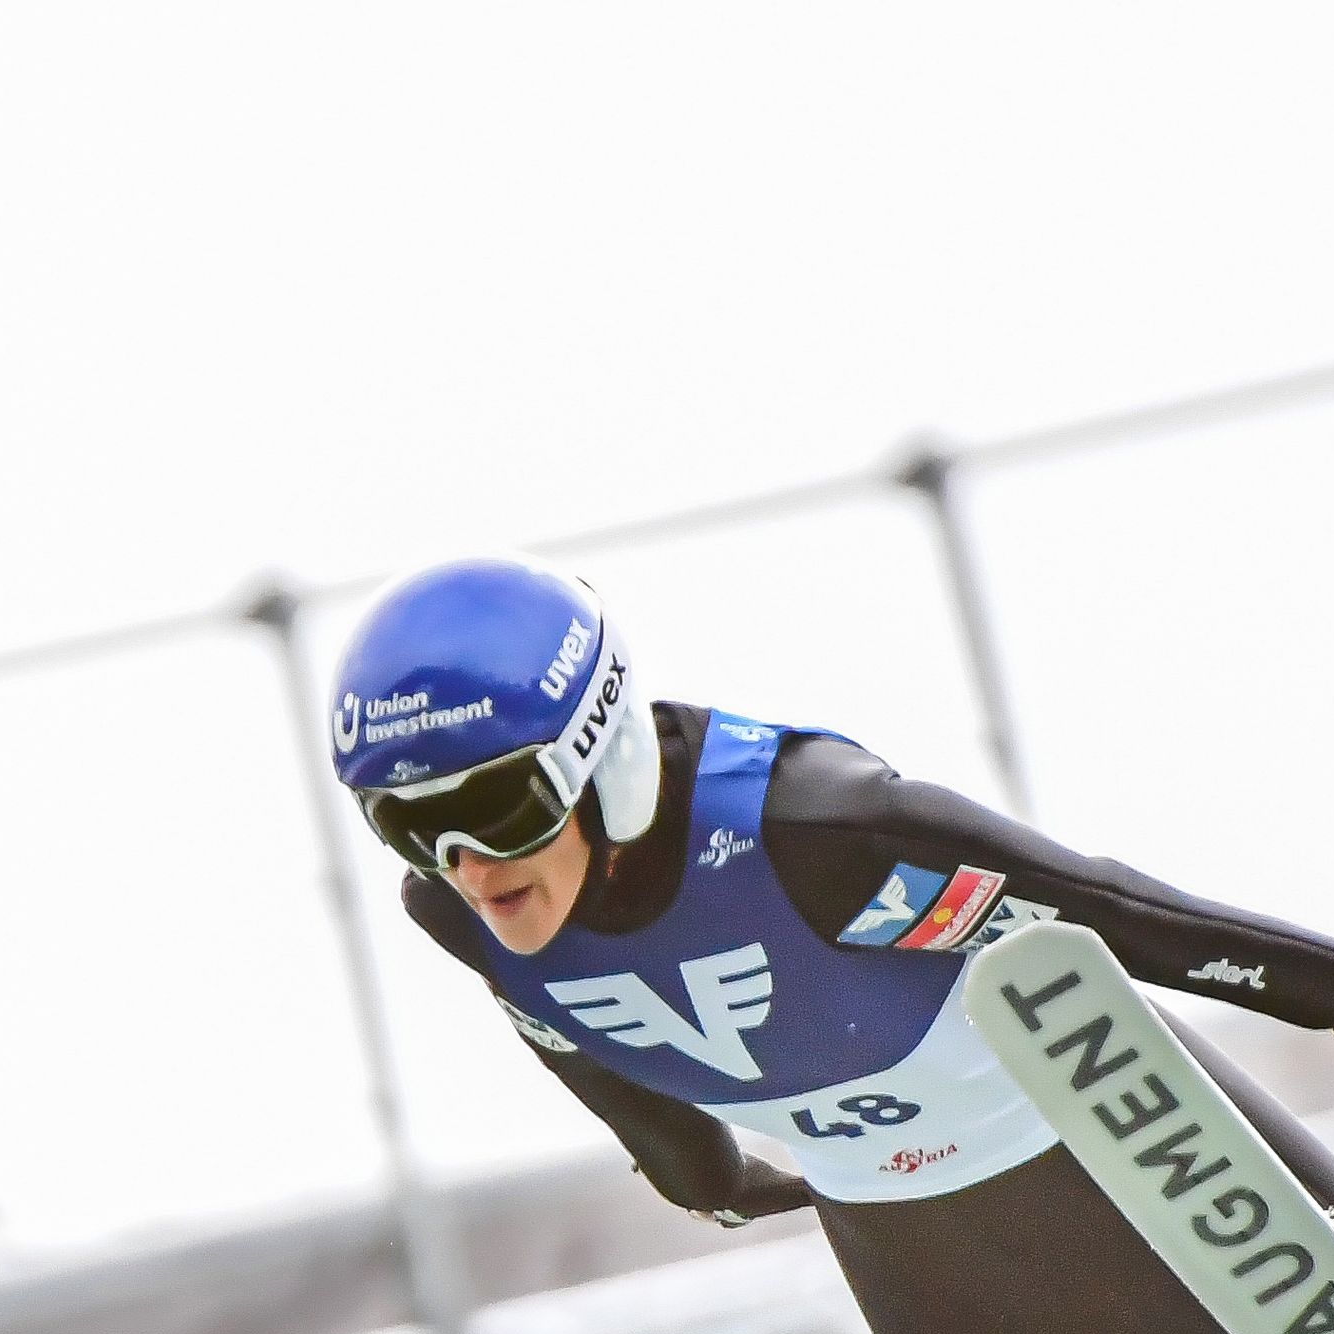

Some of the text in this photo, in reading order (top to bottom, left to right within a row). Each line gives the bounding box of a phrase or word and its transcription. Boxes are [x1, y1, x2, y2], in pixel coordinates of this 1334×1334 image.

[540, 617, 592, 702] uvex
[367, 691, 429, 720] Union
[367, 695, 494, 743] Investment
[572, 652, 626, 760] uvex
[790, 1094, 922, 1138] 48
